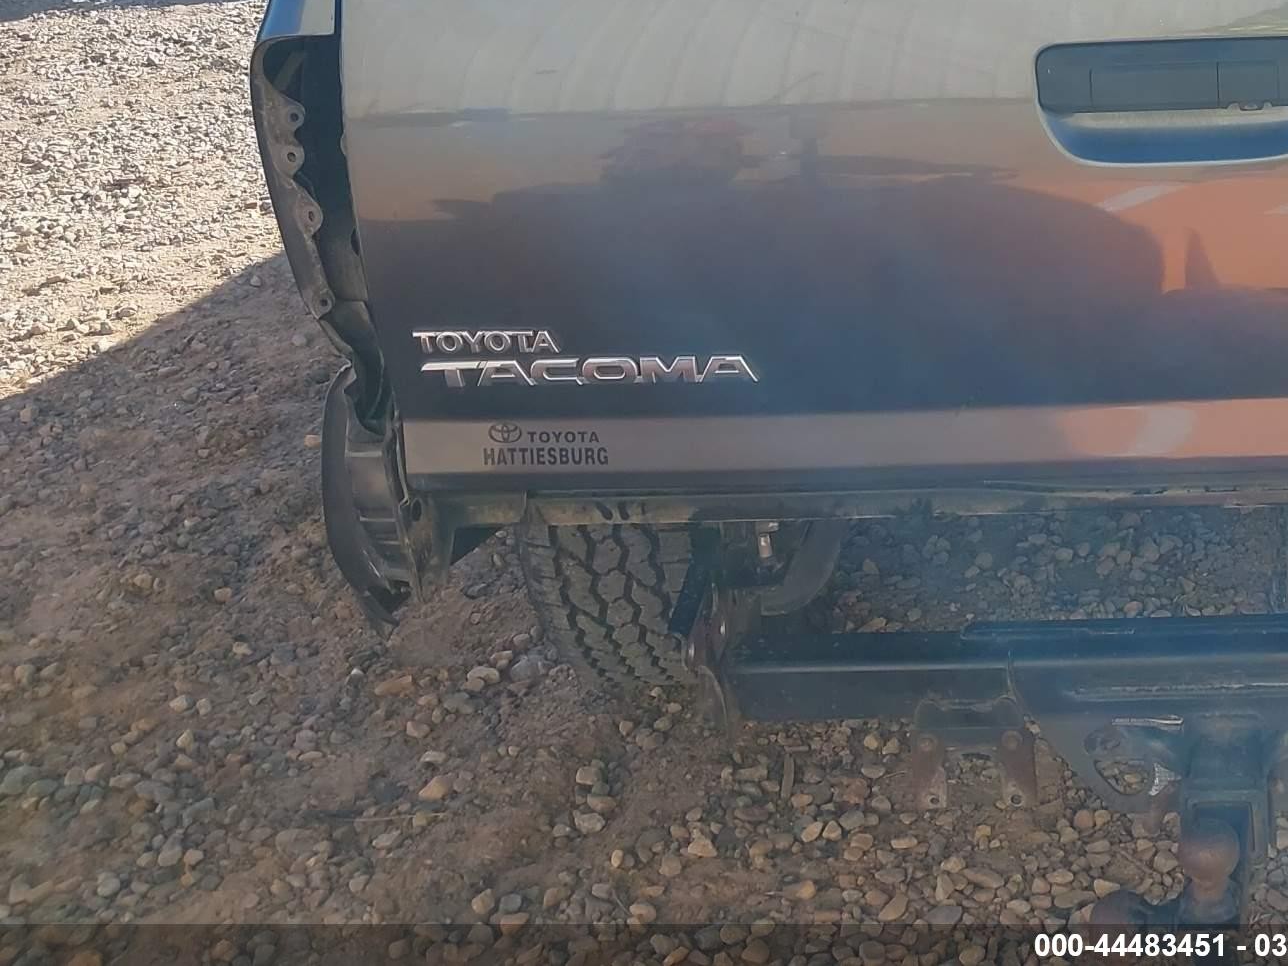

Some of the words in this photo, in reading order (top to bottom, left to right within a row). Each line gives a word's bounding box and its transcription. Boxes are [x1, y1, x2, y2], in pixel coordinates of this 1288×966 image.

[412, 330, 560, 354] TOYOTA
[420, 355, 760, 388] TACOMA
[527, 431, 600, 444] TOYOTA
[483, 447, 608, 466] HATTIESBURG
